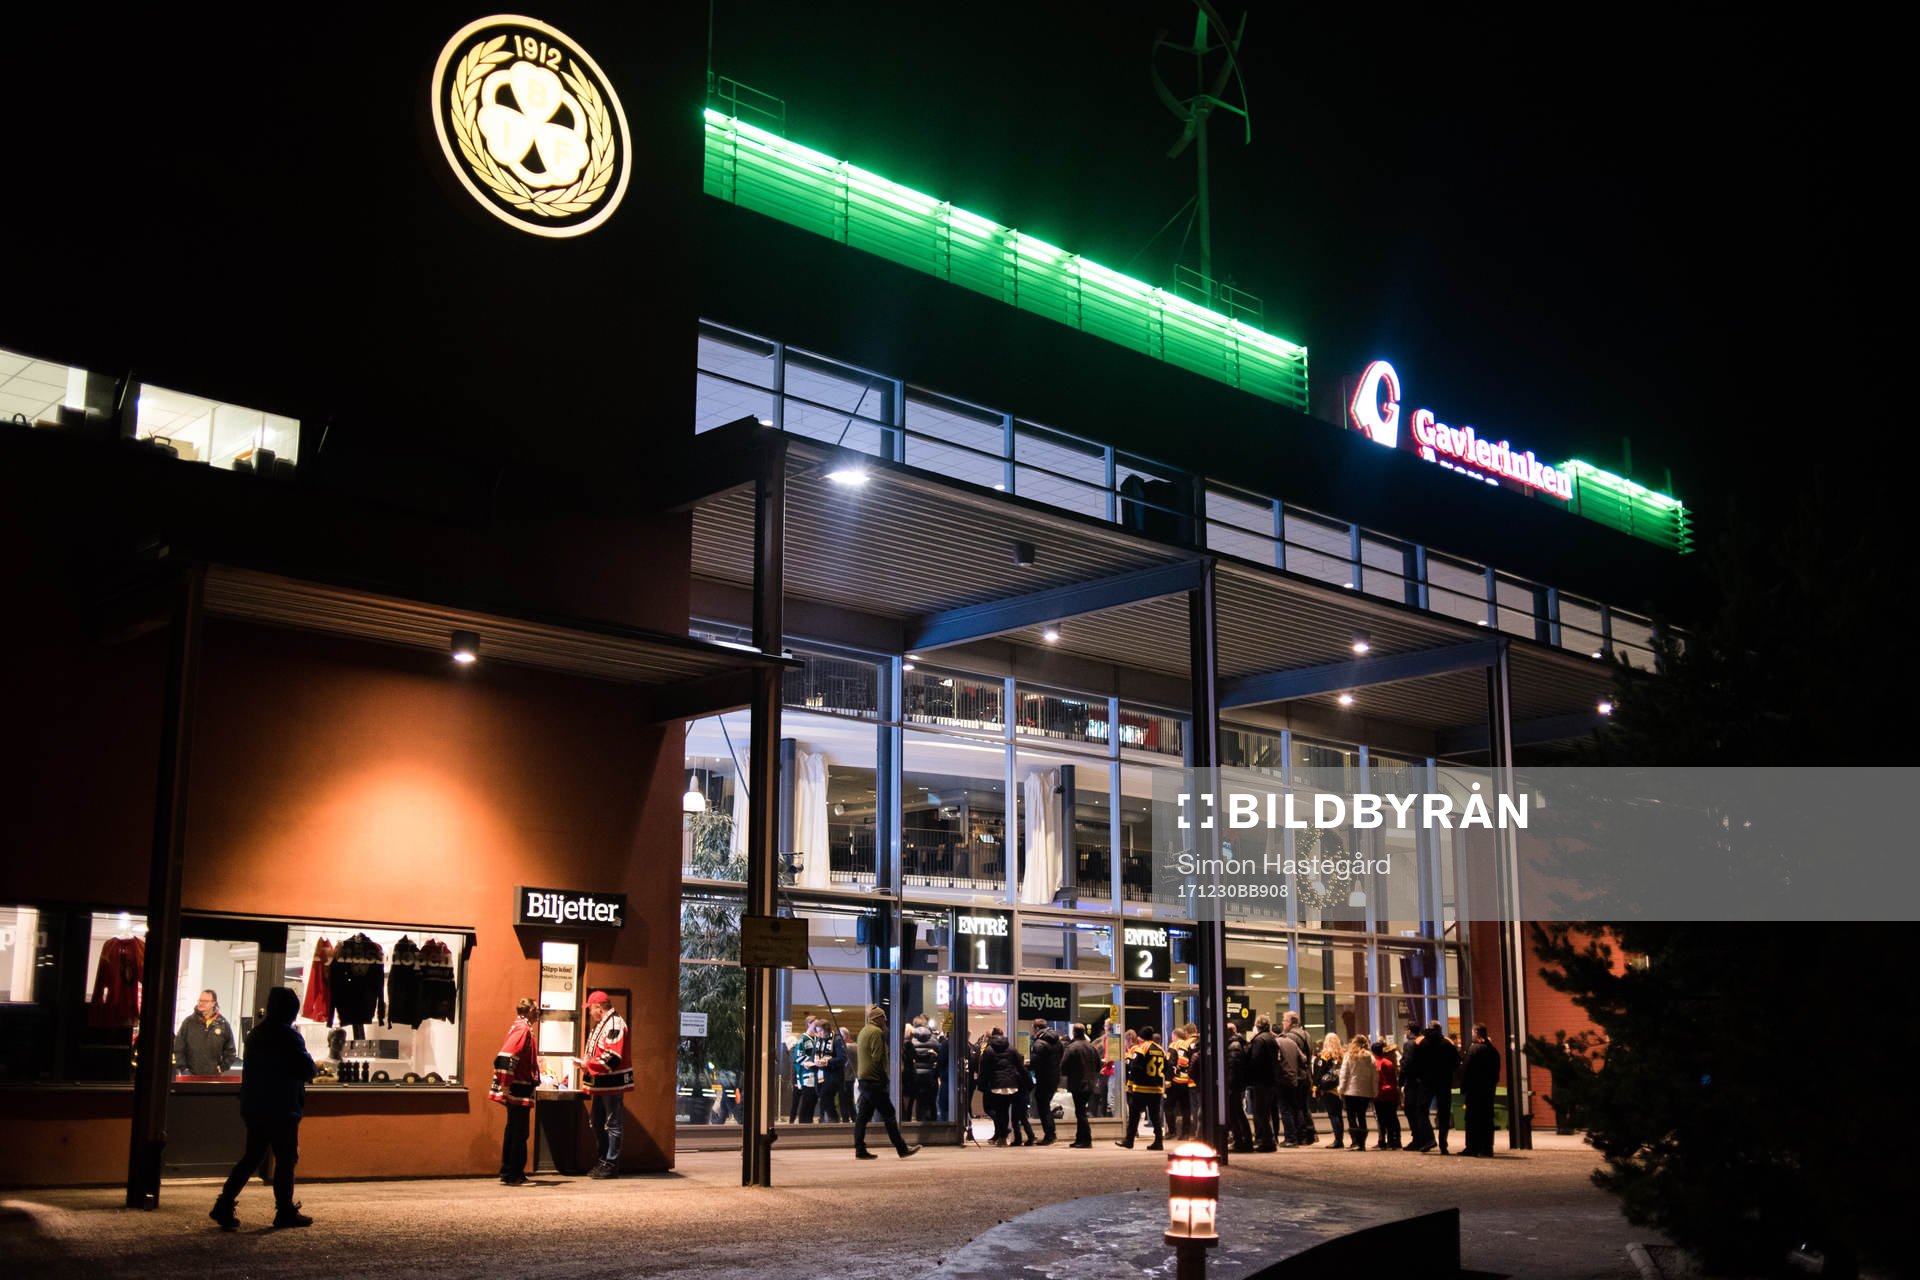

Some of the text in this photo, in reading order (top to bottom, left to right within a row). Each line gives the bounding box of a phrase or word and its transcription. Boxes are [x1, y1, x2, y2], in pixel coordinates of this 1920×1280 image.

[514, 35, 562, 71] 1912
[1411, 409, 1573, 500] Gavlerinken
[527, 892, 620, 924] Biljetter
[975, 939, 989, 970] 1
[1138, 950, 1153, 978] 2
[936, 978, 1008, 1007] Bstro
[1021, 992, 1067, 1011] Skybar
